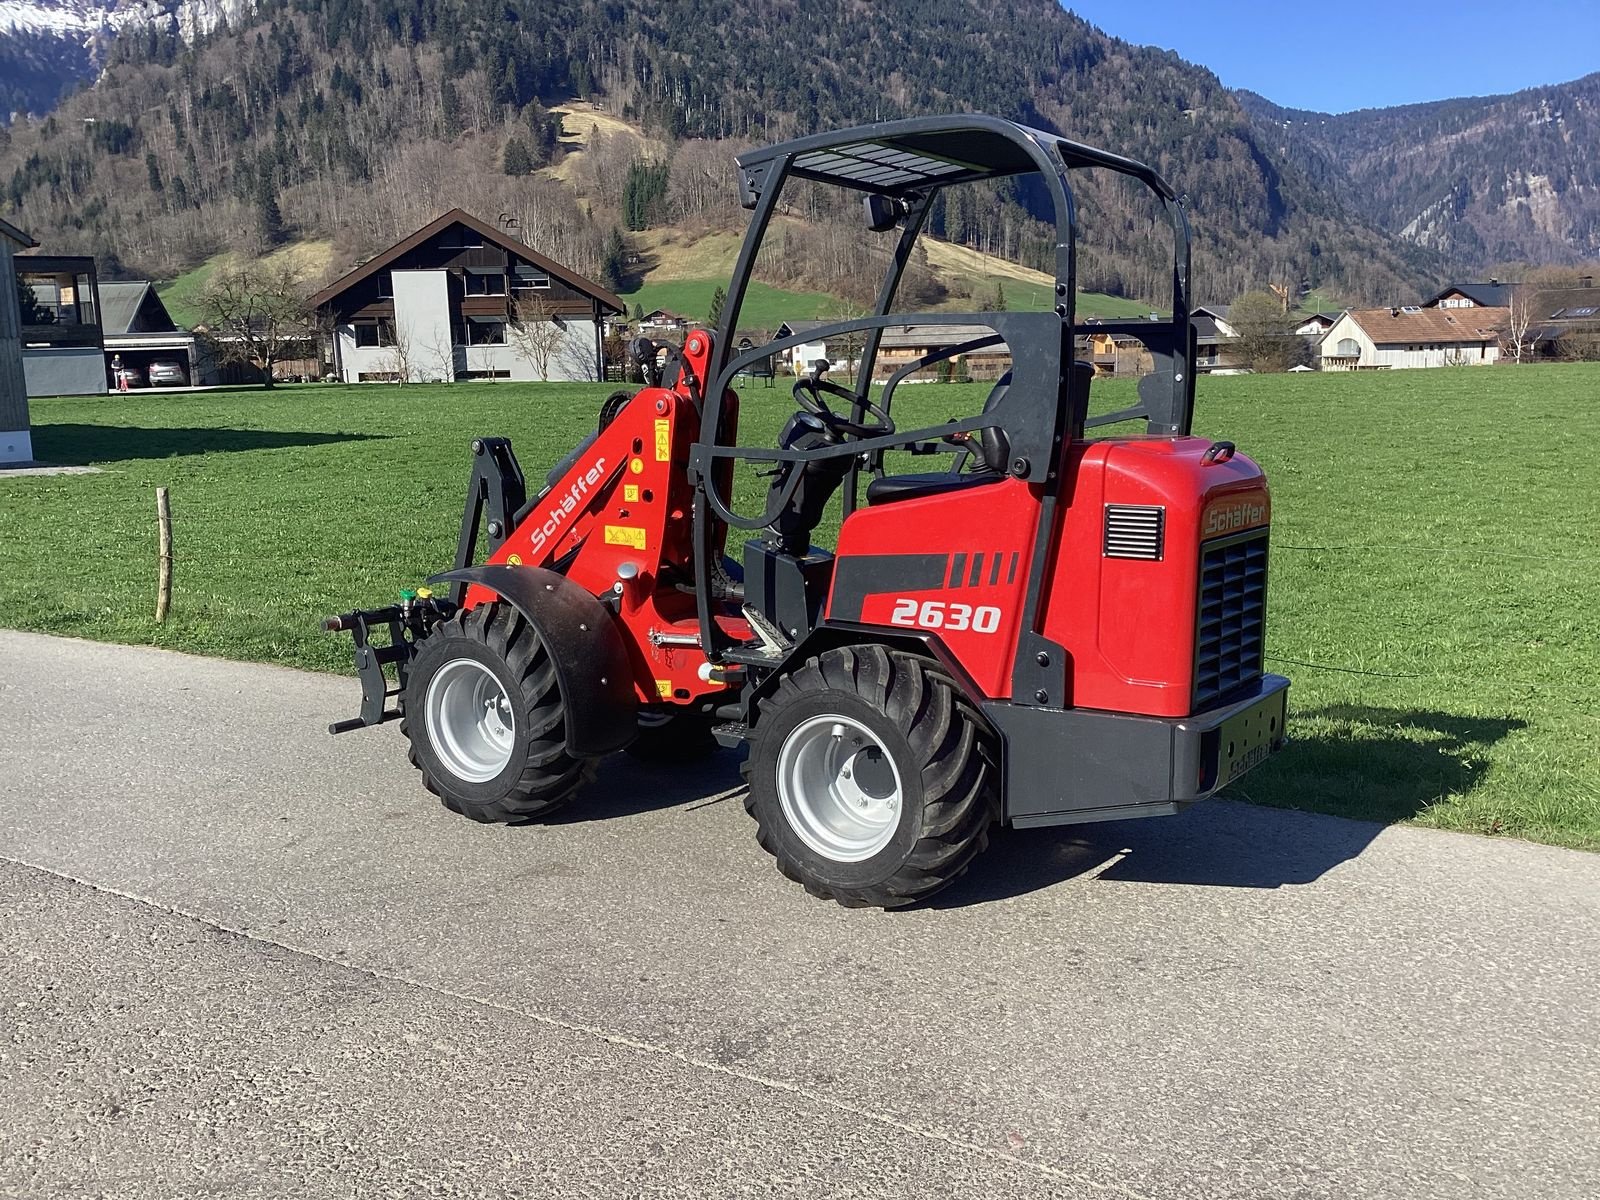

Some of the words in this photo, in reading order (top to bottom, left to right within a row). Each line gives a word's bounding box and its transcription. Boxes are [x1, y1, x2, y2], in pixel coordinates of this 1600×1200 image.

[532, 457, 606, 554] Schäffer
[1205, 502, 1265, 534] Schäffer
[891, 599, 1001, 634] 2630
